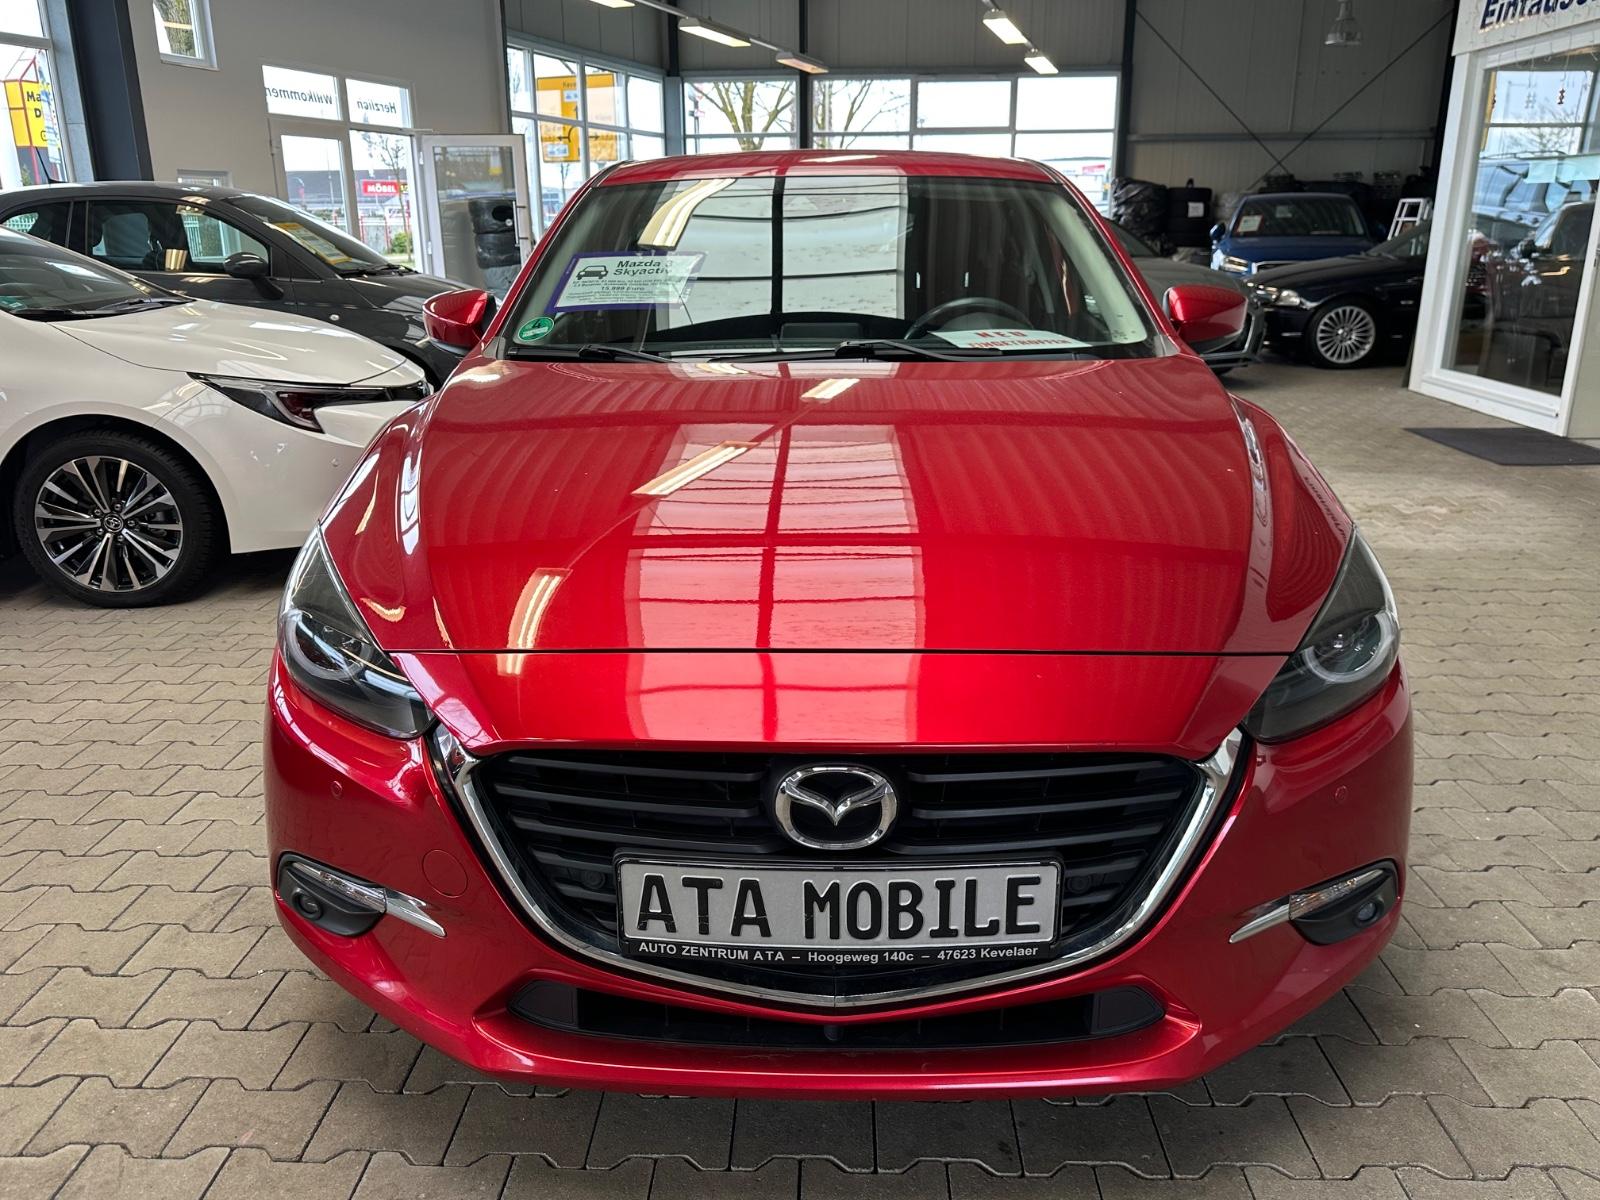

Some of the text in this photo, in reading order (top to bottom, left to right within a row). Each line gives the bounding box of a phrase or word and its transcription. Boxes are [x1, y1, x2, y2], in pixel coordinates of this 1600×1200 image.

[616, 260, 661, 268] Mazda
[974, 331, 1028, 339] NEU
[635, 873, 1041, 940] ATA MOBILE
[638, 942, 677, 955] AUTO
[681, 945, 749, 960] ZENTRUM
[753, 951, 785, 961] ATA
[808, 951, 879, 964] Hoogeweg
[883, 951, 914, 962] 140c
[937, 950, 977, 960] 47623
[980, 946, 1039, 959] Kevelaer
